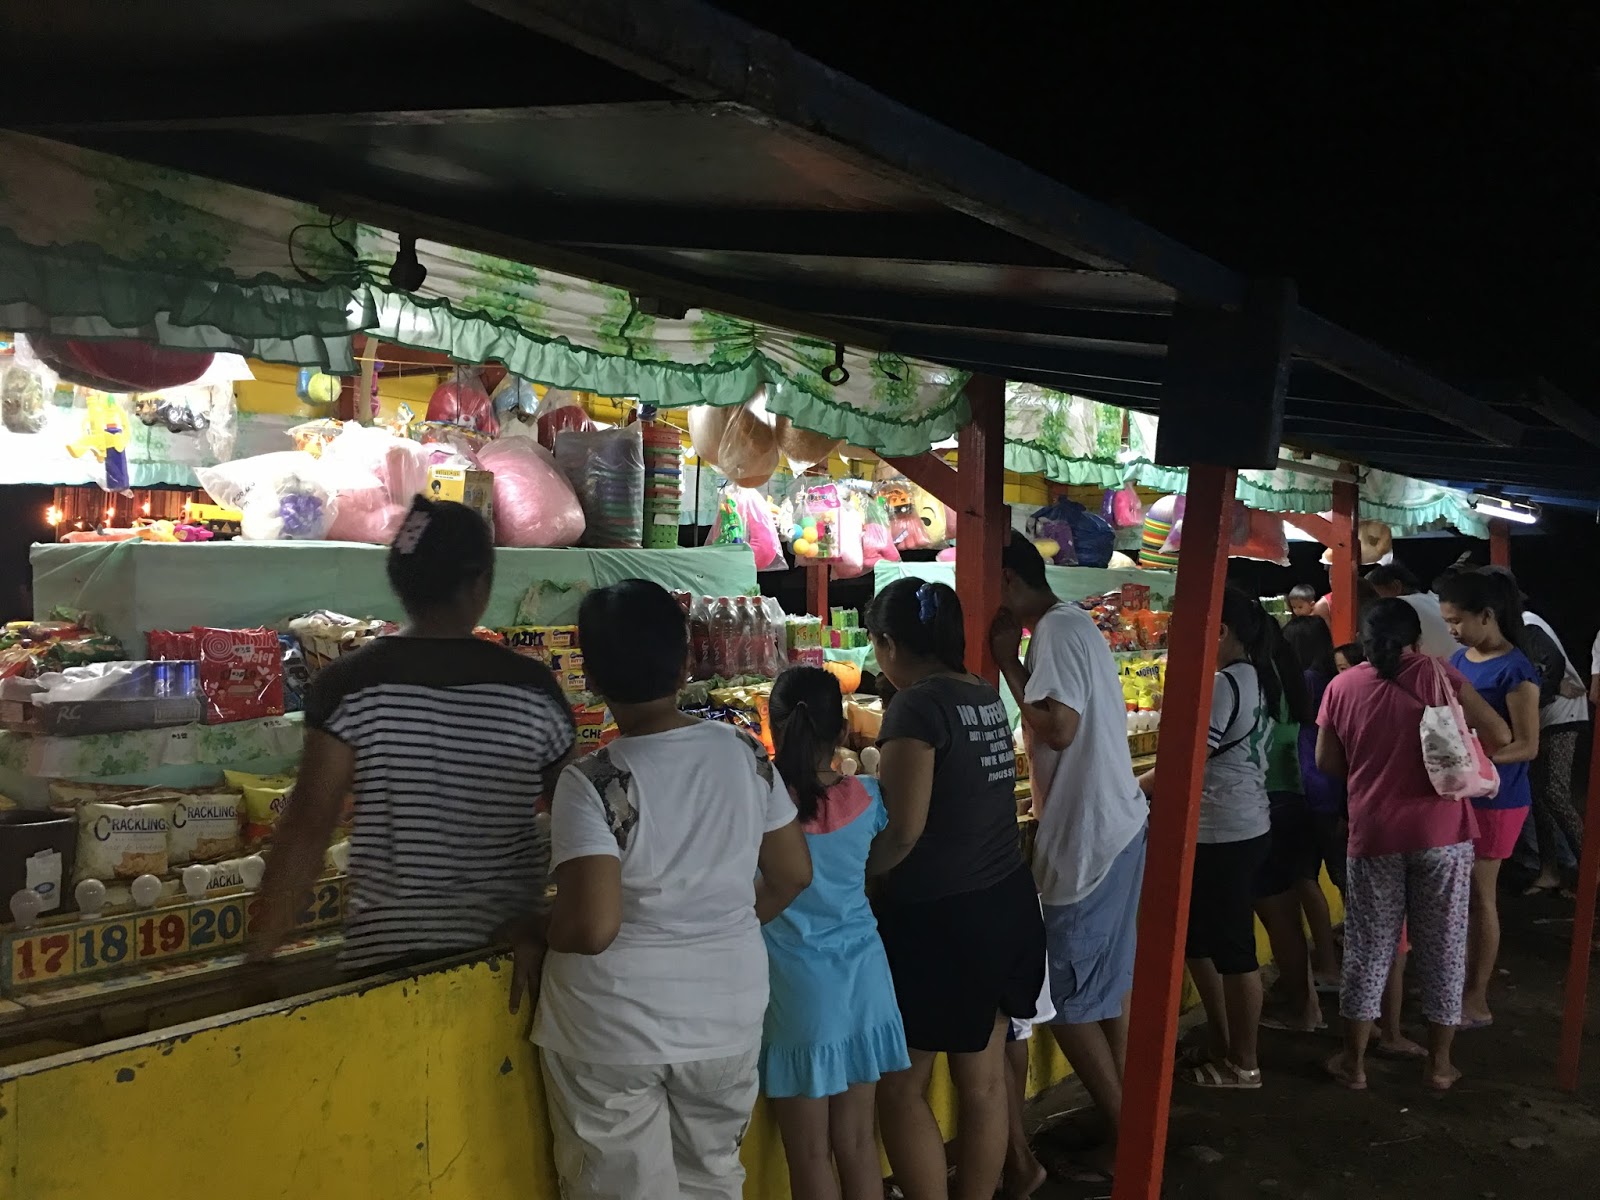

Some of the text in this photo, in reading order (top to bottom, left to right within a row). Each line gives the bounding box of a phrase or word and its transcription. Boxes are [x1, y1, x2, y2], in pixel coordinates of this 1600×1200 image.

[57, 704, 82, 724] RC
[956, 705, 978, 726] NO
[988, 766, 1015, 782] moussy
[17, 934, 71, 980] 17
[79, 924, 128, 968] 18
[139, 914, 185, 957] 19
[191, 904, 242, 946] 20
